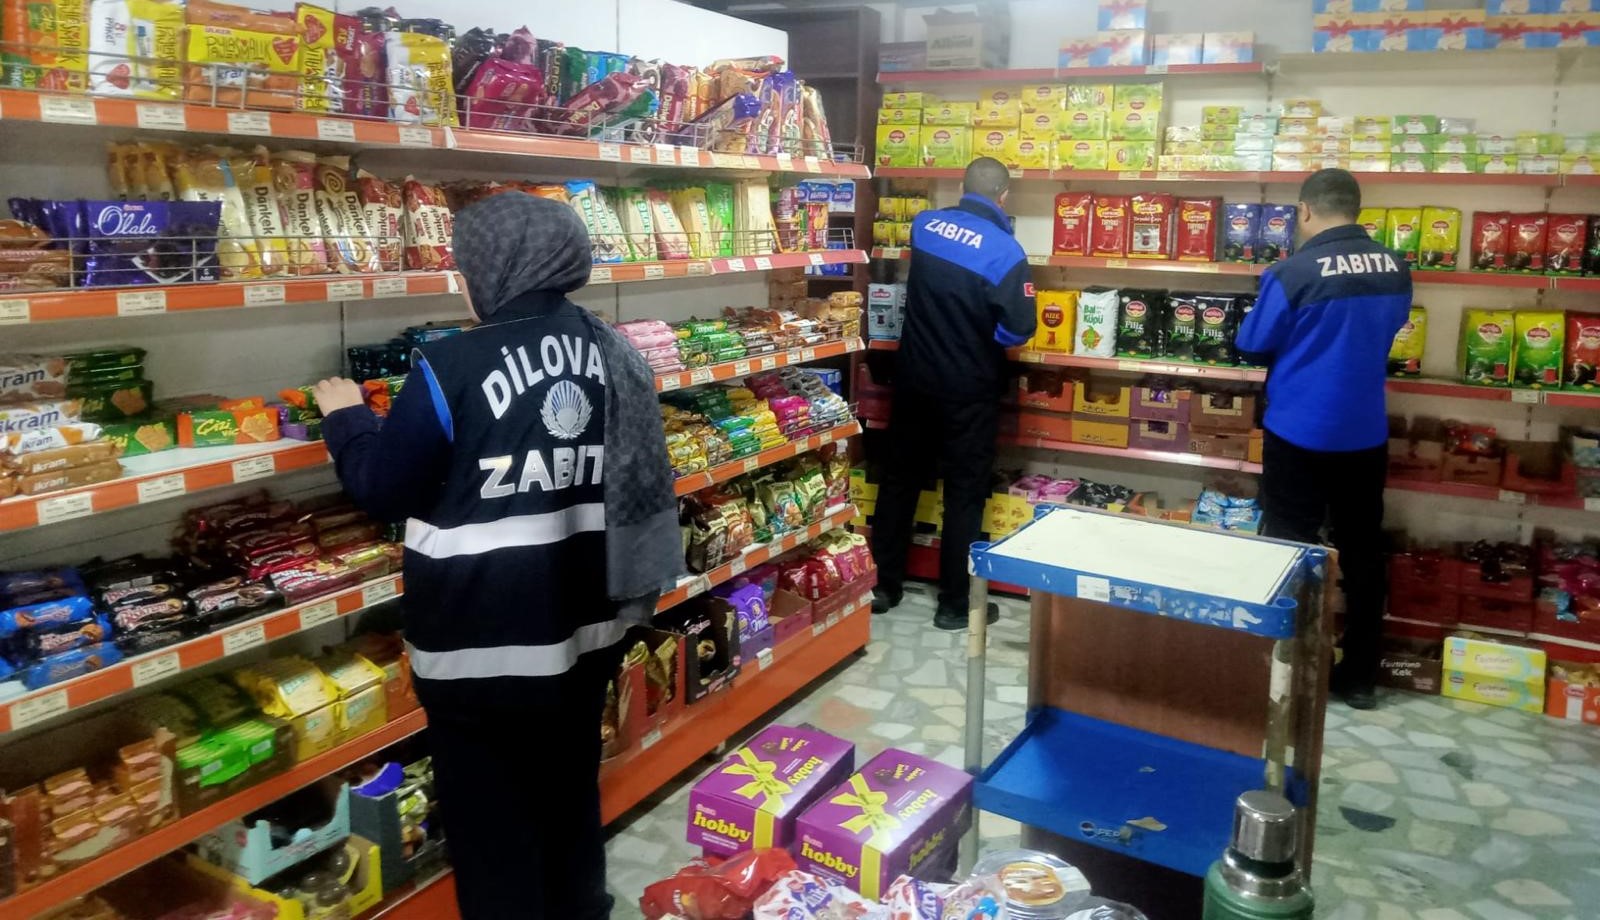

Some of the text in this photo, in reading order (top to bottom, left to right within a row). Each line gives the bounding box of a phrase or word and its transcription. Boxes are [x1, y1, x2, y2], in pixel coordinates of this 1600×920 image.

[254, 185, 274, 236] Dankek
[924, 219, 984, 249] ZABITA
[1317, 253, 1398, 277] ZABITA
[481, 334, 606, 420] DİLOVA
[478, 445, 605, 499] ZABIT
[693, 811, 752, 842] hobby
[801, 843, 859, 878] hobby
